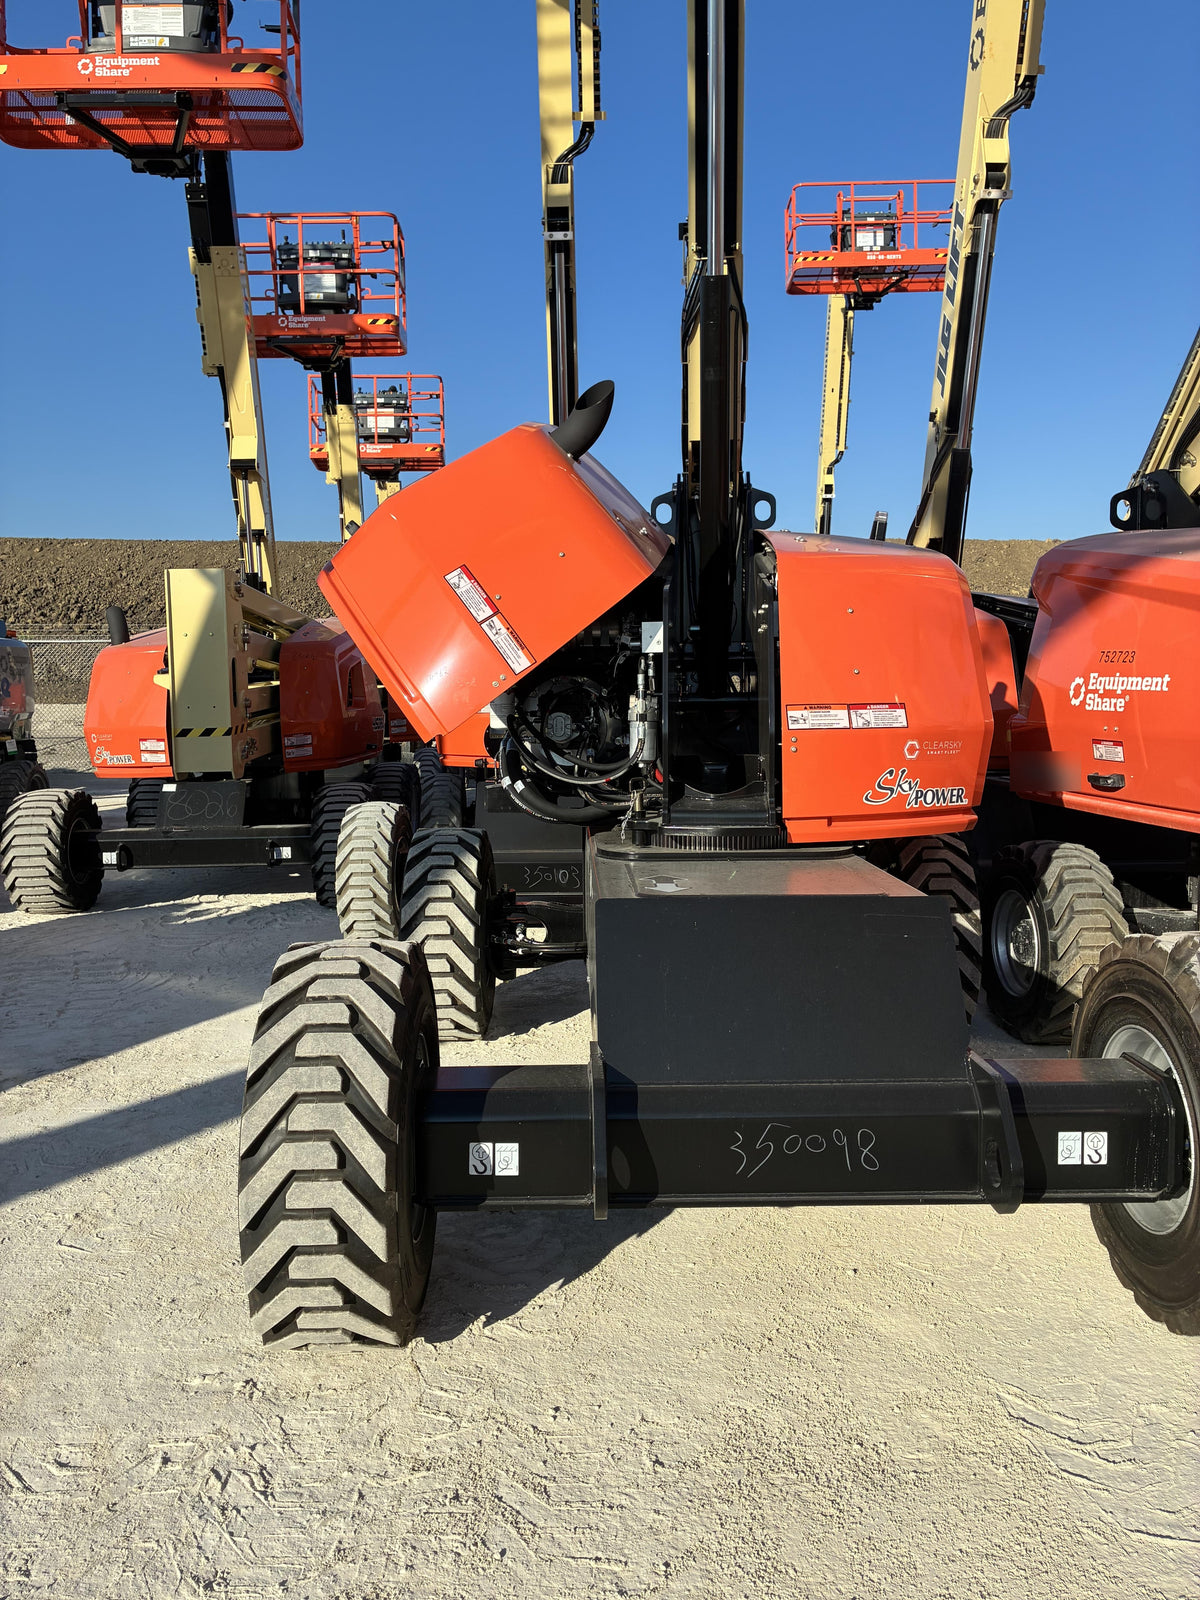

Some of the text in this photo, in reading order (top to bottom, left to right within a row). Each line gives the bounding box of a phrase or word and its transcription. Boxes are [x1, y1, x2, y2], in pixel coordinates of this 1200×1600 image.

[95, 56, 160, 68] Equipment
[936, 200, 965, 399] JLG LIFT
[288, 315, 327, 323] Equipment
[1099, 650, 1136, 663] 752723
[1087, 672, 1171, 694] Equipment
[922, 740, 963, 750] CLEARSKY
[523, 865, 581, 889] 350103
[730, 1122, 880, 1179] 350098
